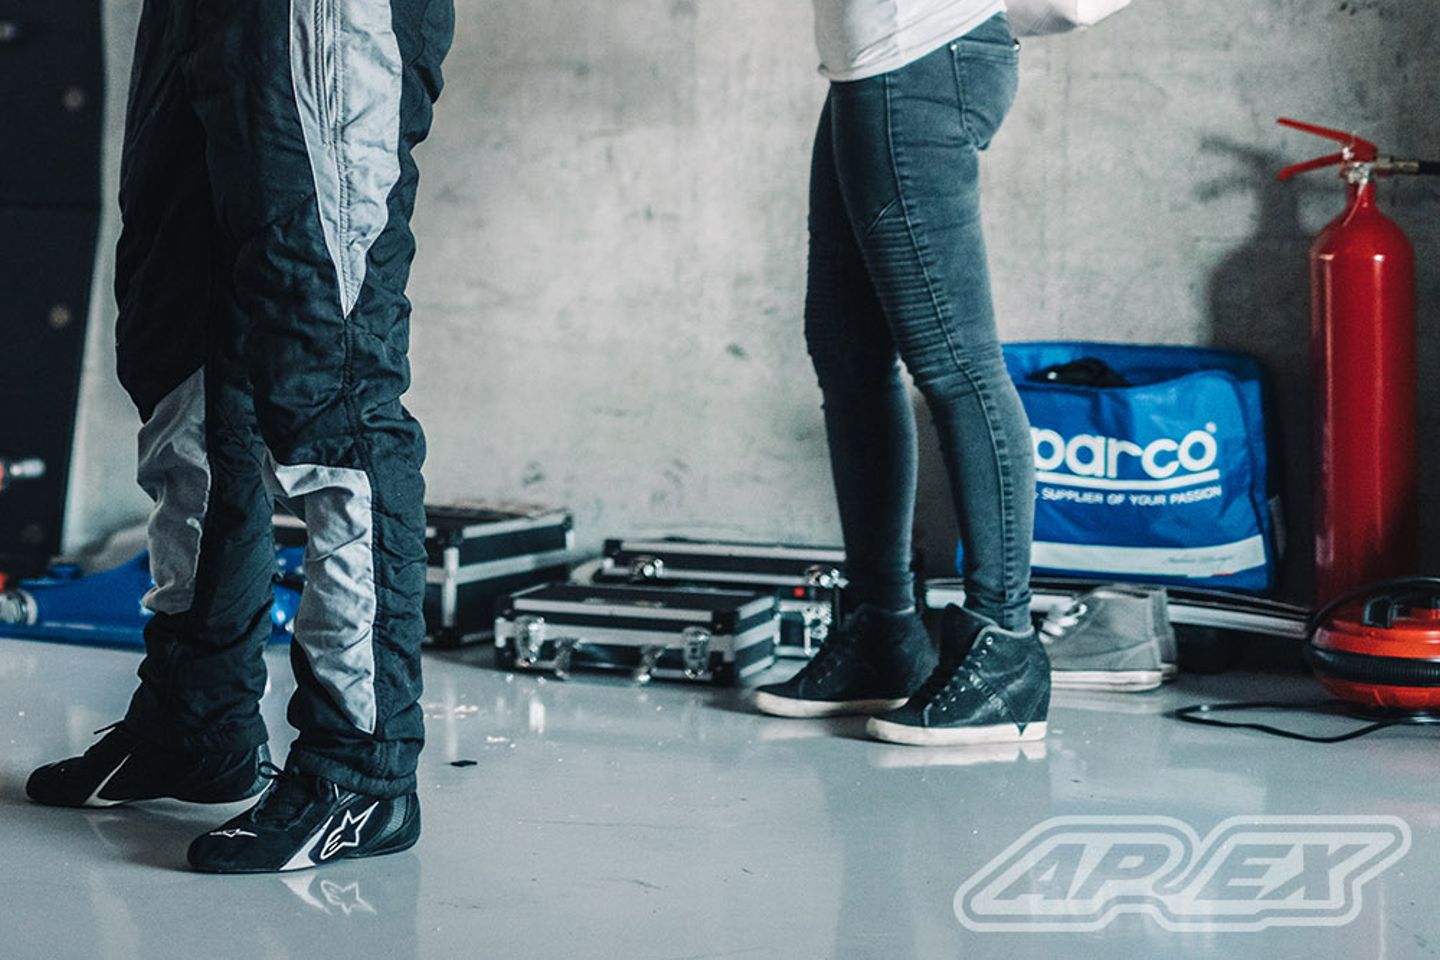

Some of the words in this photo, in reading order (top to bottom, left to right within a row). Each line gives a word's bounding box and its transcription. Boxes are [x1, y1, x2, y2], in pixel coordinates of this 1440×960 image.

[1041, 486, 1104, 505] SUPPLIER
[1107, 493, 1126, 506] OF
[1129, 494, 1167, 506] YOUR
[1169, 485, 1222, 505] PASSION
